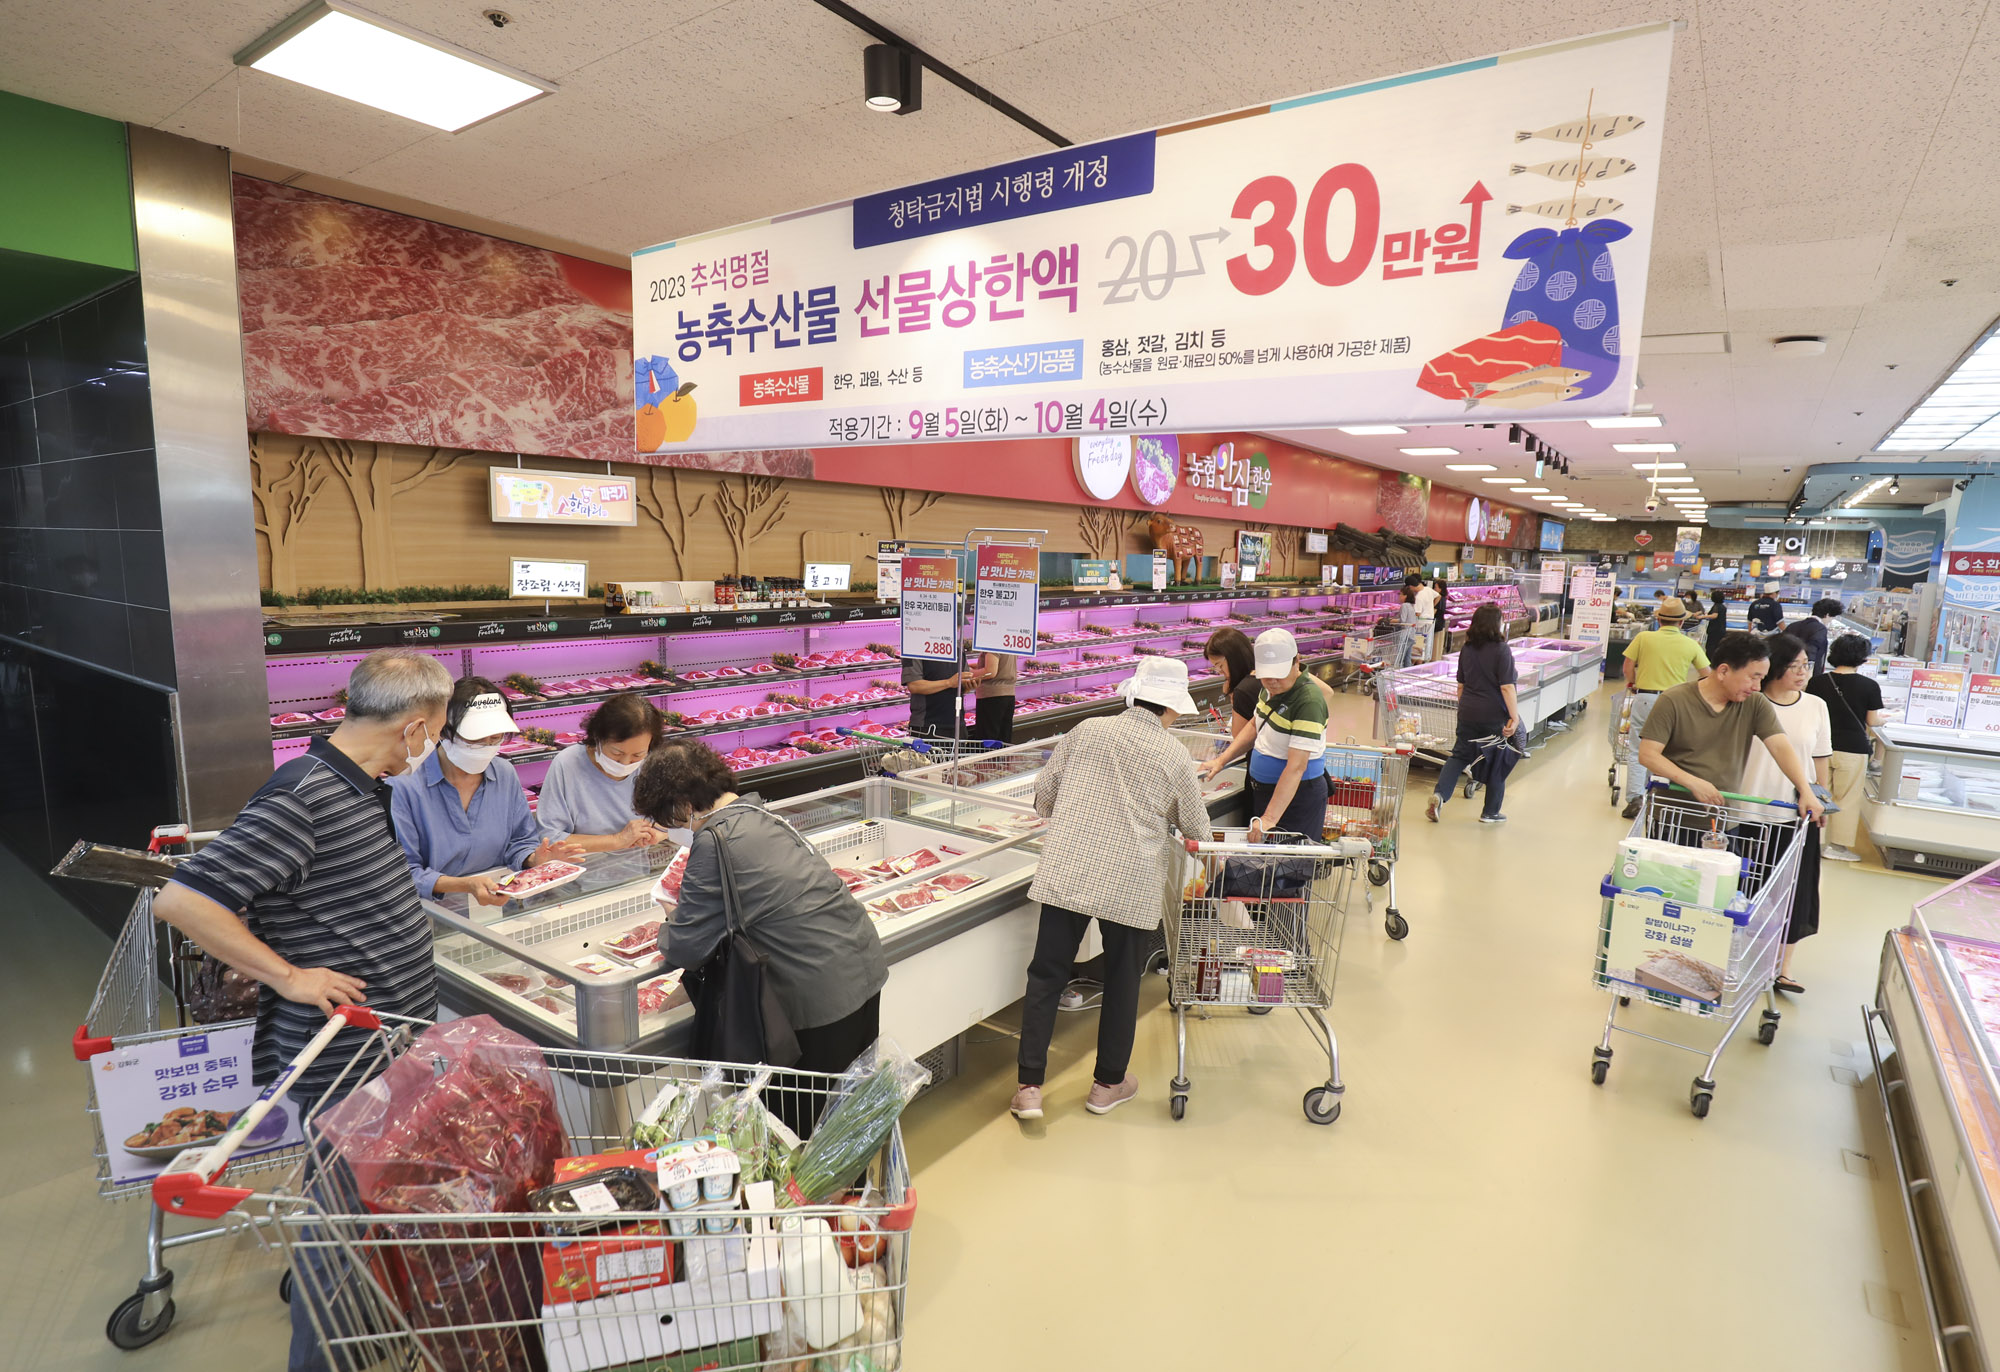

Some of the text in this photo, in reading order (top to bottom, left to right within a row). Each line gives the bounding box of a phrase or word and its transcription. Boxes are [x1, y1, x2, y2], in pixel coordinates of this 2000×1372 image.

[888, 156, 1109, 228] 청탁금지법 시행령 개정
[1225, 162, 1480, 297] 30만원
[650, 249, 769, 302] 2023 추석명절
[1100, 229, 1178, 305] 20
[675, 243, 1079, 362] 농축수산물 선물상한액
[1101, 329, 1227, 358] 홍삼, 젓갈, 김치 등
[969, 348, 1076, 379] 농축수산가공품
[1099, 357, 1152, 376] (농수산물을
[1218, 349, 1254, 366] 50%를
[1257, 347, 1281, 363] 넘게
[1283, 343, 1333, 361] 사용하여
[1336, 340, 1377, 357] 가공한
[1379, 336, 1411, 355] 제품)
[753, 375, 810, 399] 농축수산물
[833, 367, 923, 391] 한우, 과일, 수산 등
[829, 416, 892, 442] 적용기간
[908, 411, 941, 438] 9월
[945, 407, 1009, 437] 5일(화)
[1034, 400, 1084, 433] 10월
[1088, 396, 1167, 431] 4일(수)
[1189, 442, 1273, 507] 농협 안심 한우
[1758, 535, 1807, 556] 활어
[811, 575, 842, 588] 불고기
[904, 577, 912, 588] 살
[913, 577, 938, 589] 맛나는
[980, 565, 989, 577] 살
[990, 565, 1017, 578] 맛나는
[517, 579, 551, 592] 장조림
[558, 580, 580, 592] 산적
[980, 588, 994, 598] 한우
[904, 600, 915, 610] 한우
[924, 641, 953, 655] 2,880
[1003, 634, 1032, 649] 3,180
[1927, 717, 1953, 727] 4,980
[1645, 929, 1694, 949] 강화 섬쌀
[155, 1056, 238, 1081] 맛보면 중독!
[159, 1082, 198, 1101] 강화
[203, 1074, 239, 1094] 순무
